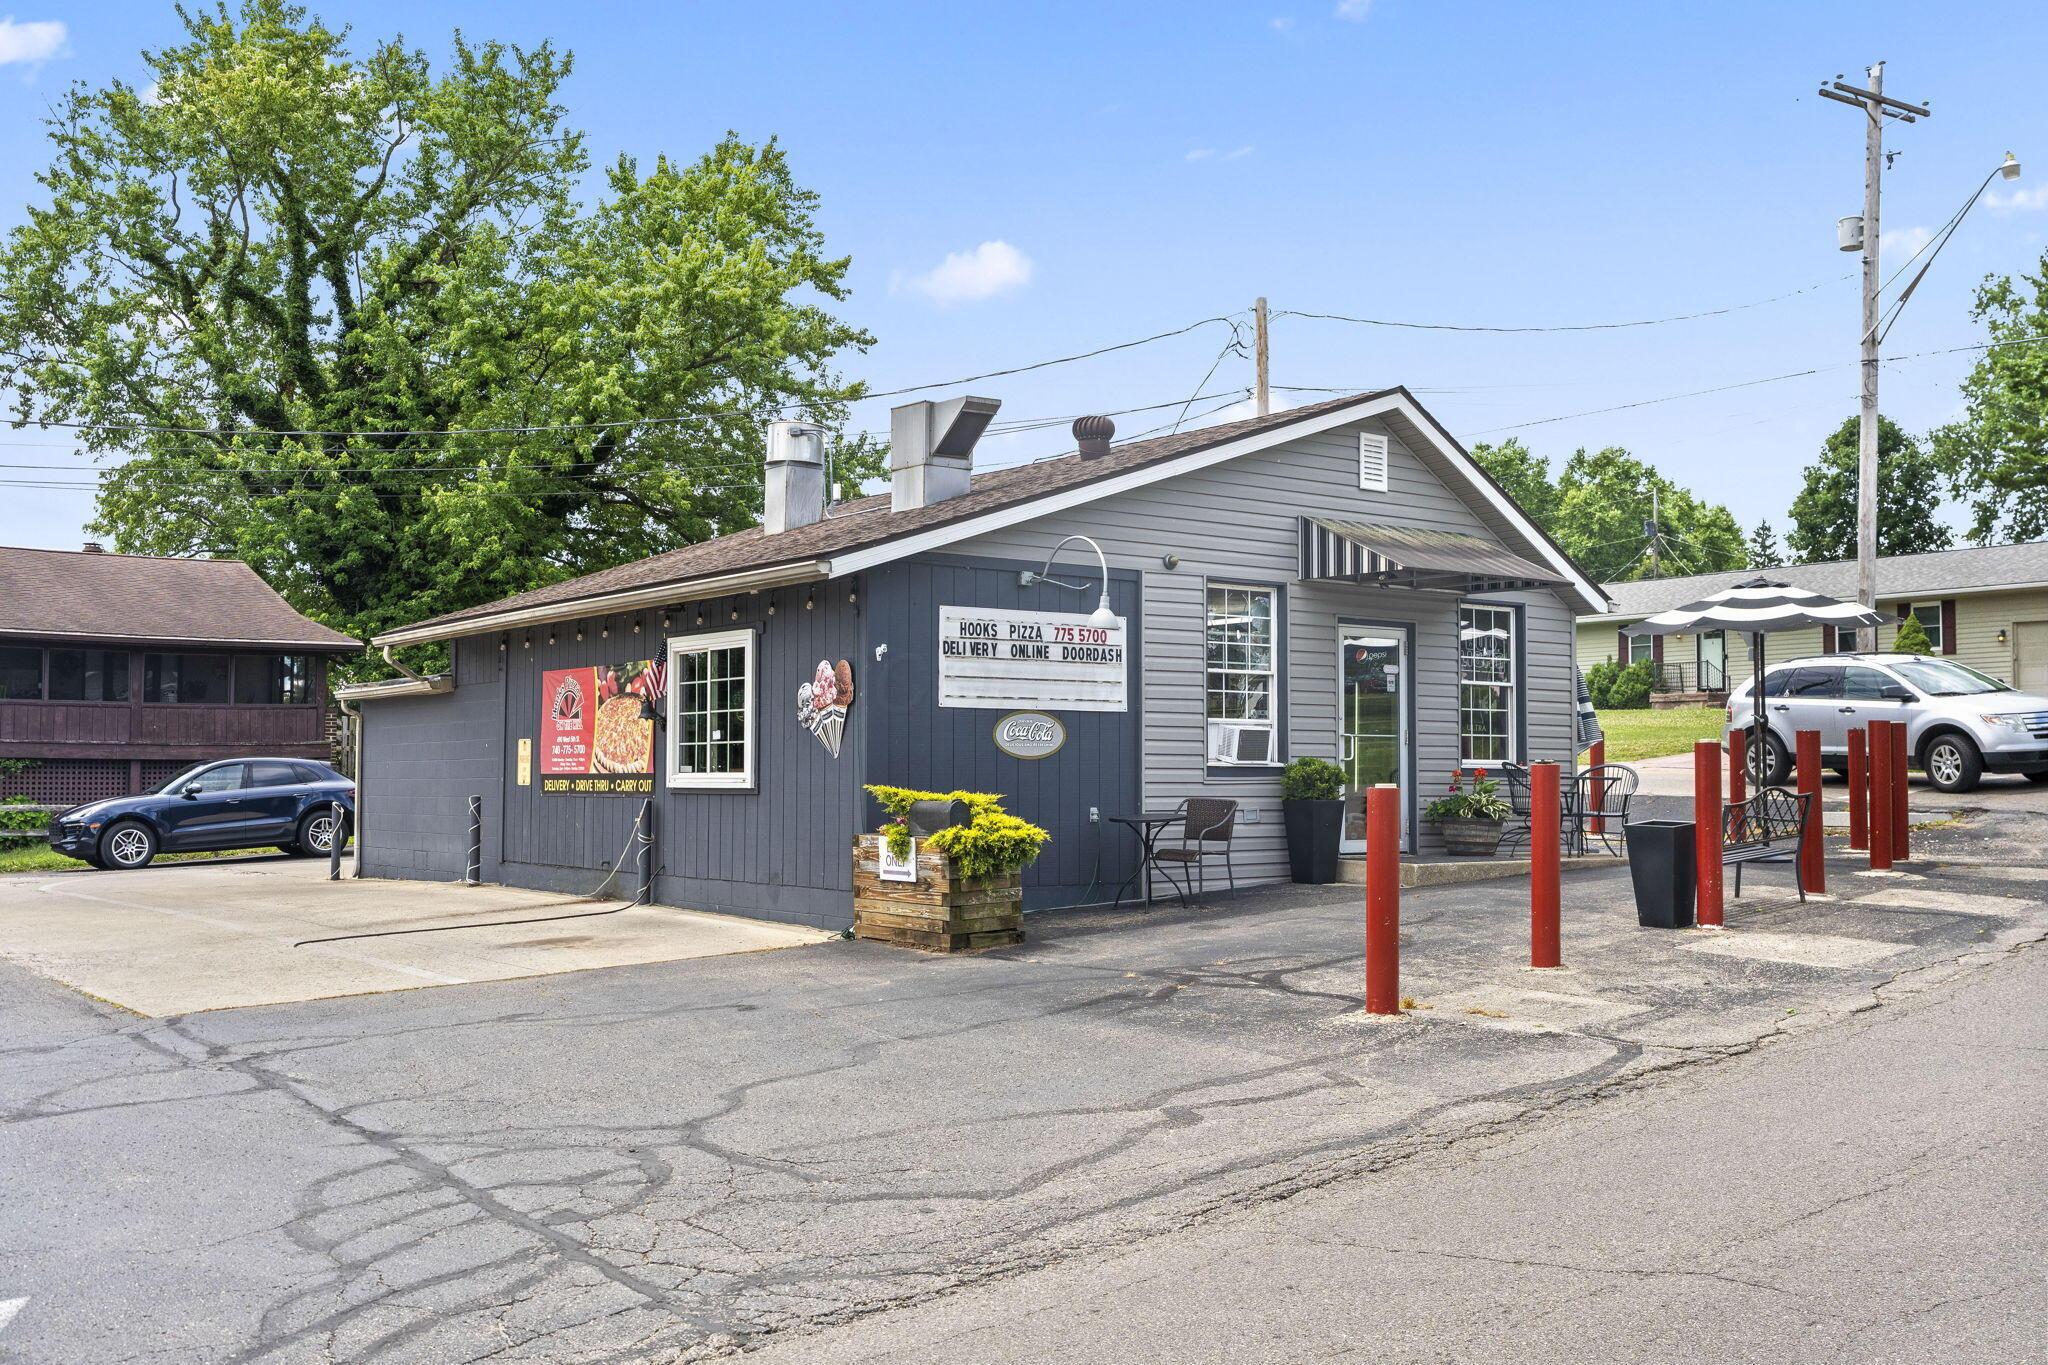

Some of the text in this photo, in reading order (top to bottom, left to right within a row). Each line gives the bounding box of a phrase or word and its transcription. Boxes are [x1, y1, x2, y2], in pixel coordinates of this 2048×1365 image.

[960, 621, 1107, 644] HOOKS PIZZA 775 5700
[943, 640, 1122, 663] DELIVERY ONLINE DOORDASH
[544, 779, 652, 792] DELIVERY DRIVE THRU CARRY OUT
